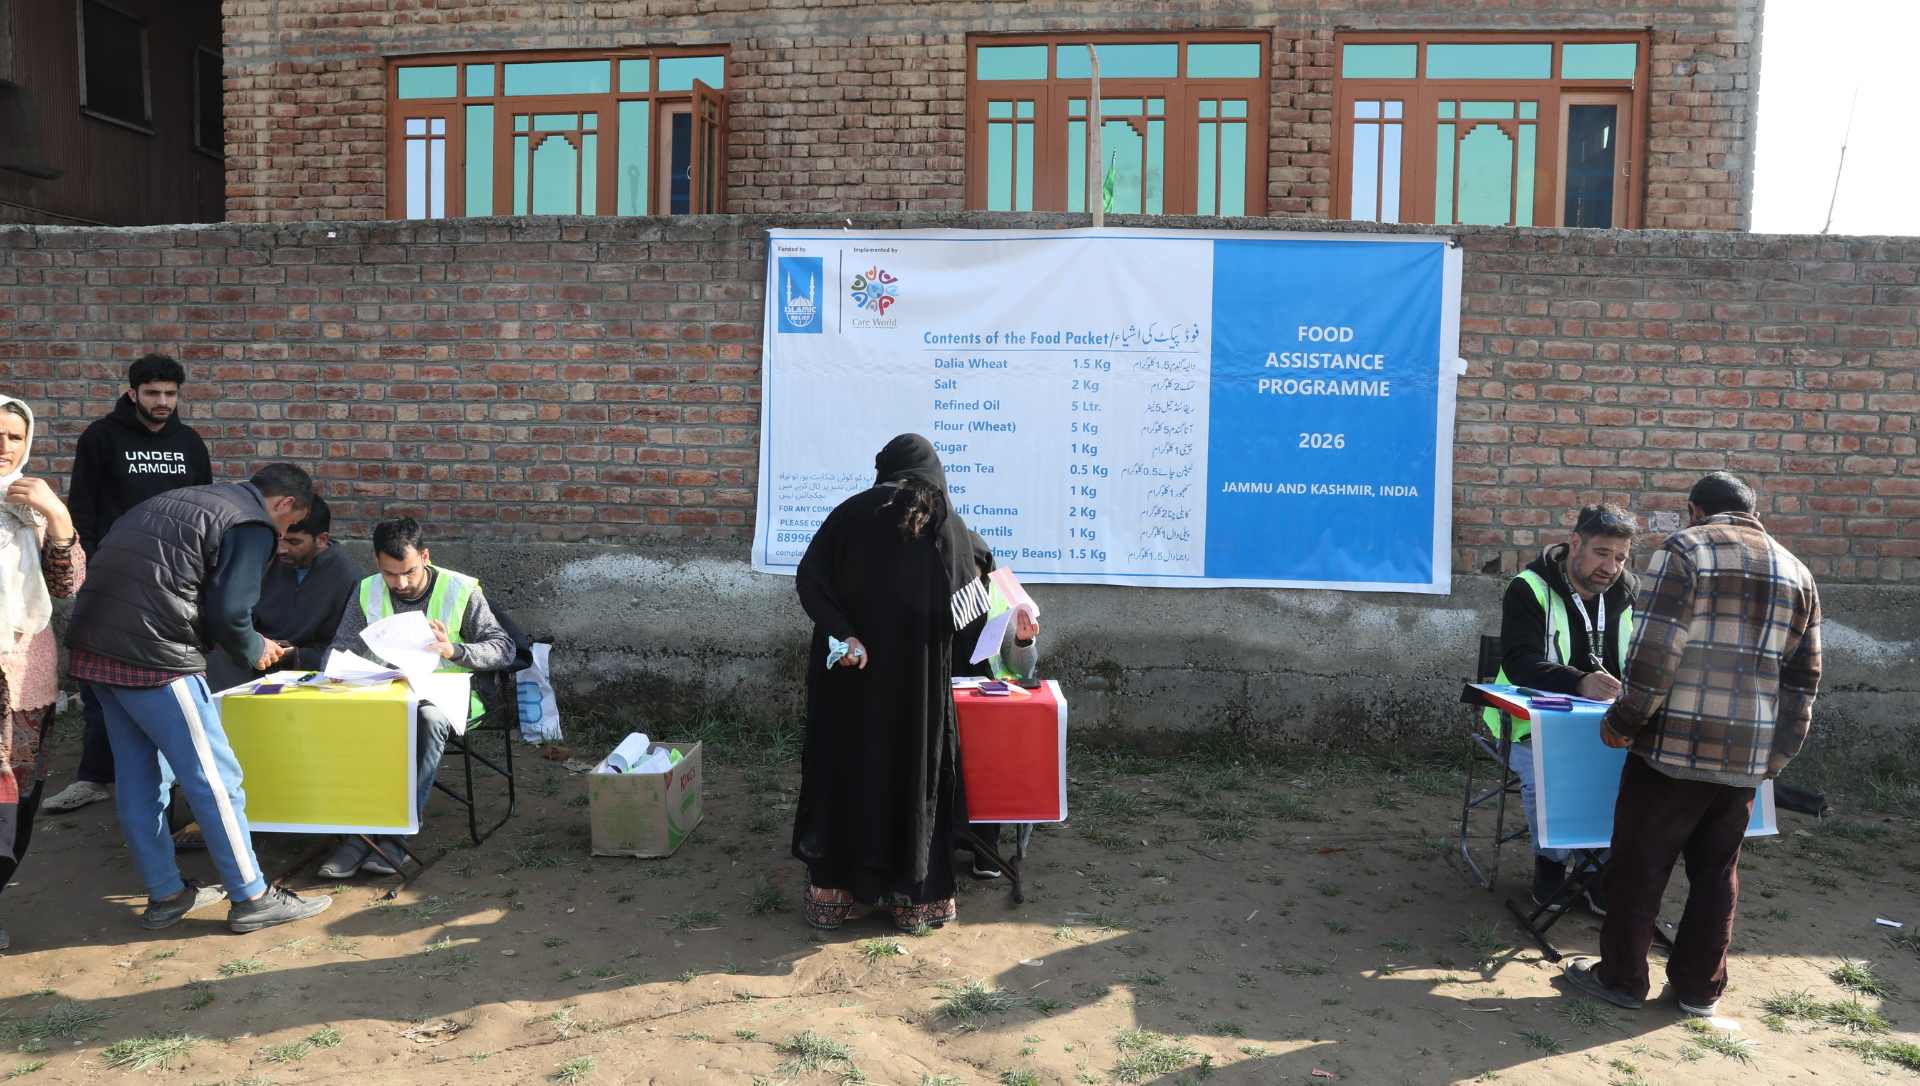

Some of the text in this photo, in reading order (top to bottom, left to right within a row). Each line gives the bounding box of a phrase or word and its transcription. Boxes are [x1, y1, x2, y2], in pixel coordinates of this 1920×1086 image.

[852, 318, 897, 327] Care World
[924, 331, 981, 344] Contents
[985, 331, 999, 344] of
[1004, 332, 1025, 344] the
[1030, 332, 1060, 344] Food
[1298, 326, 1354, 343] FOOD
[934, 358, 1111, 372] Dalia Wheat 1.5 Kg
[1264, 352, 1385, 370] ASSISTANCE
[934, 379, 1100, 393] Salt 2 Kg
[1258, 379, 1390, 397] PROGRAMME
[934, 400, 1101, 412] Refined Oil 5 Ltr.
[934, 421, 1098, 436] Flour (Wheat) 5 Kg
[1299, 433, 1345, 448] 2026
[125, 451, 185, 461] UNDER
[934, 442, 1097, 456] Sugar 1 Kg
[128, 463, 186, 474] ARMOUR
[943, 463, 1108, 478] pton Tea 0.5 Kg
[949, 484, 1096, 499] tes 1 Kg
[1222, 482, 1418, 497] JAMMU AND KASHMIR, INDIA
[973, 505, 1018, 515] Channa
[1069, 507, 1077, 516] 2
[1080, 507, 1096, 519] Kg
[777, 533, 811, 543] 88996
[1070, 528, 1075, 538] 1
[1080, 528, 1096, 540] Kg
[1022, 548, 1062, 560] Beans)
[1069, 549, 1088, 559] 1.5
[1091, 549, 1106, 562] Kg
